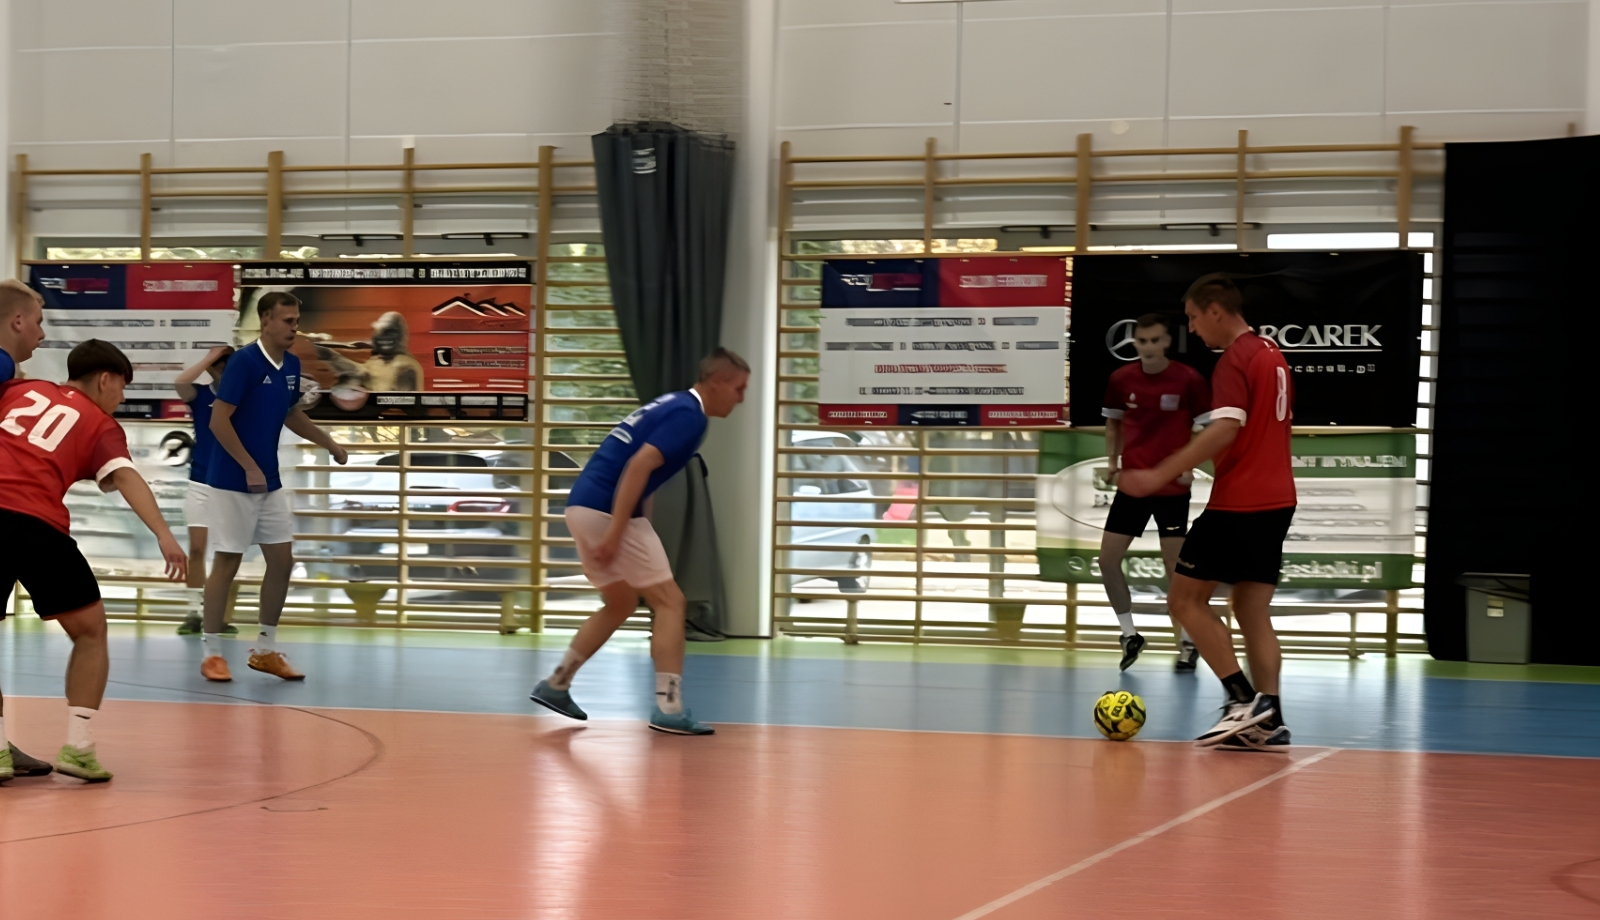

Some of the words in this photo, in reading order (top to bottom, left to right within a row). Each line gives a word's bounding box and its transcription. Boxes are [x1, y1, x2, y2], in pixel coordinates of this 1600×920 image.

[1259, 324, 1382, 347] RCAREK
[0, 389, 80, 452] 20
[1276, 366, 1287, 421] 8
